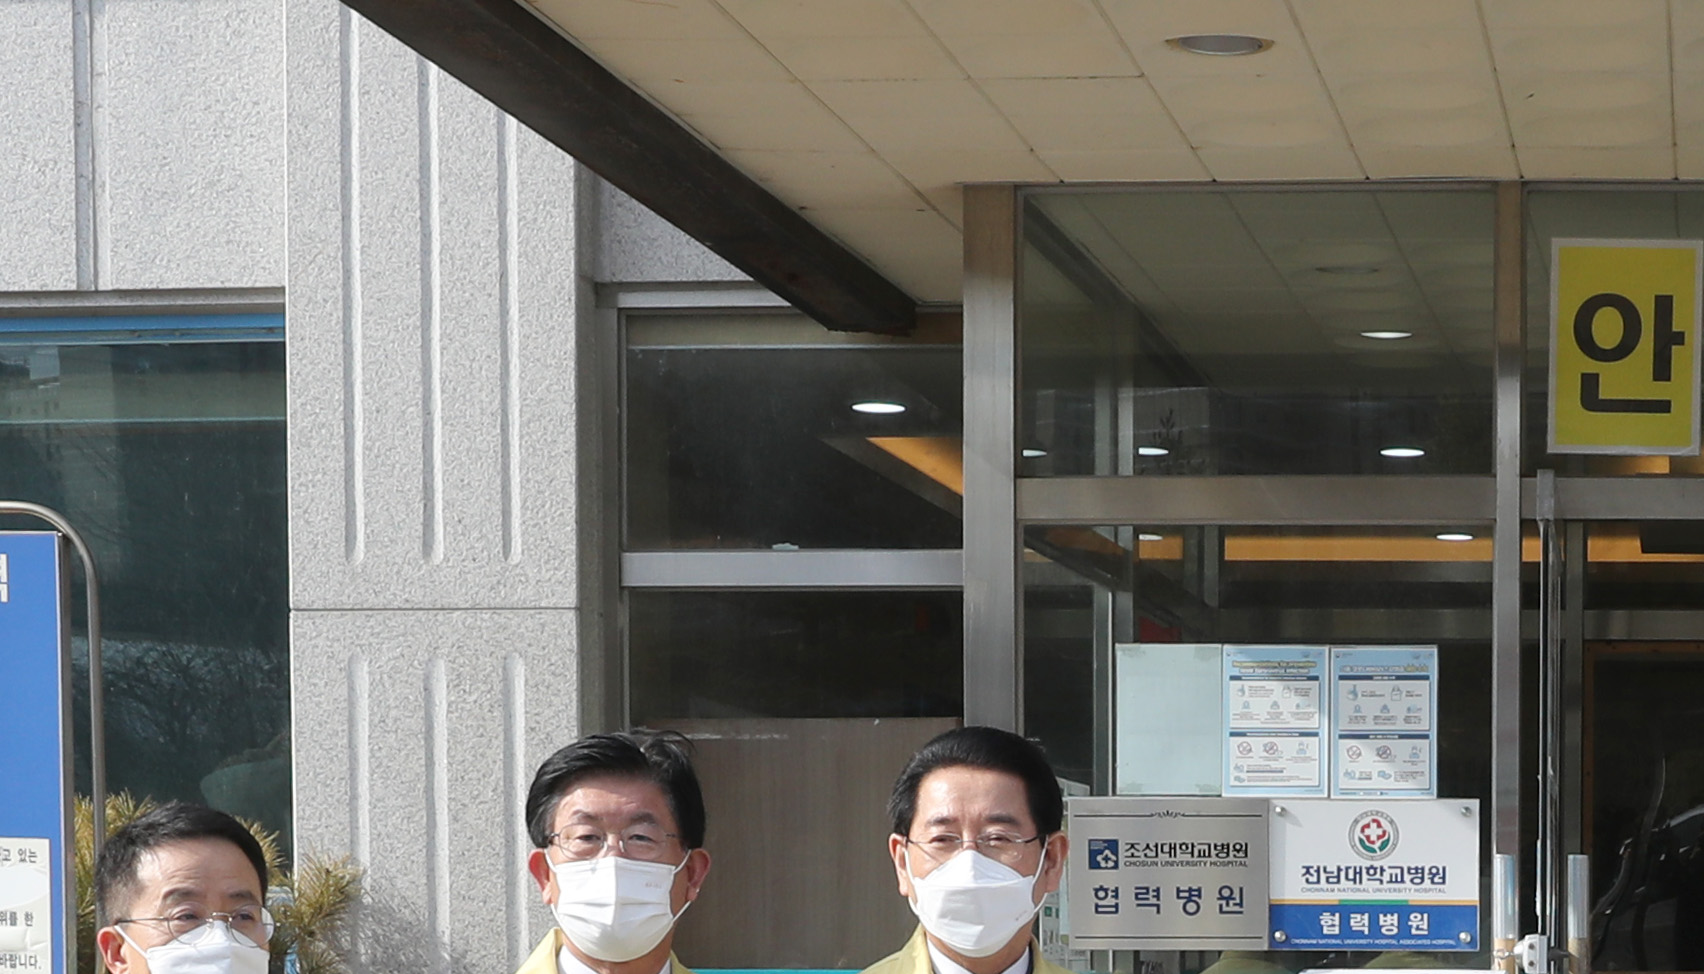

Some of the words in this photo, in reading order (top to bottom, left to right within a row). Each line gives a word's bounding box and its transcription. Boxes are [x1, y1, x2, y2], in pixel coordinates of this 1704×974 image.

[17, 848, 38, 864] 있는
[1124, 842, 1248, 859] 조선대학교병원
[1124, 860, 1159, 868] CHOSUN
[1160, 860, 1209, 868] UNIVERSITY
[1209, 860, 1248, 868] HOSPITAL
[1301, 864, 1447, 886] 전남대학교병원
[1093, 885, 1244, 916] 협력병원
[24, 911, 34, 927] 한
[1319, 911, 1430, 936] 협력병원
